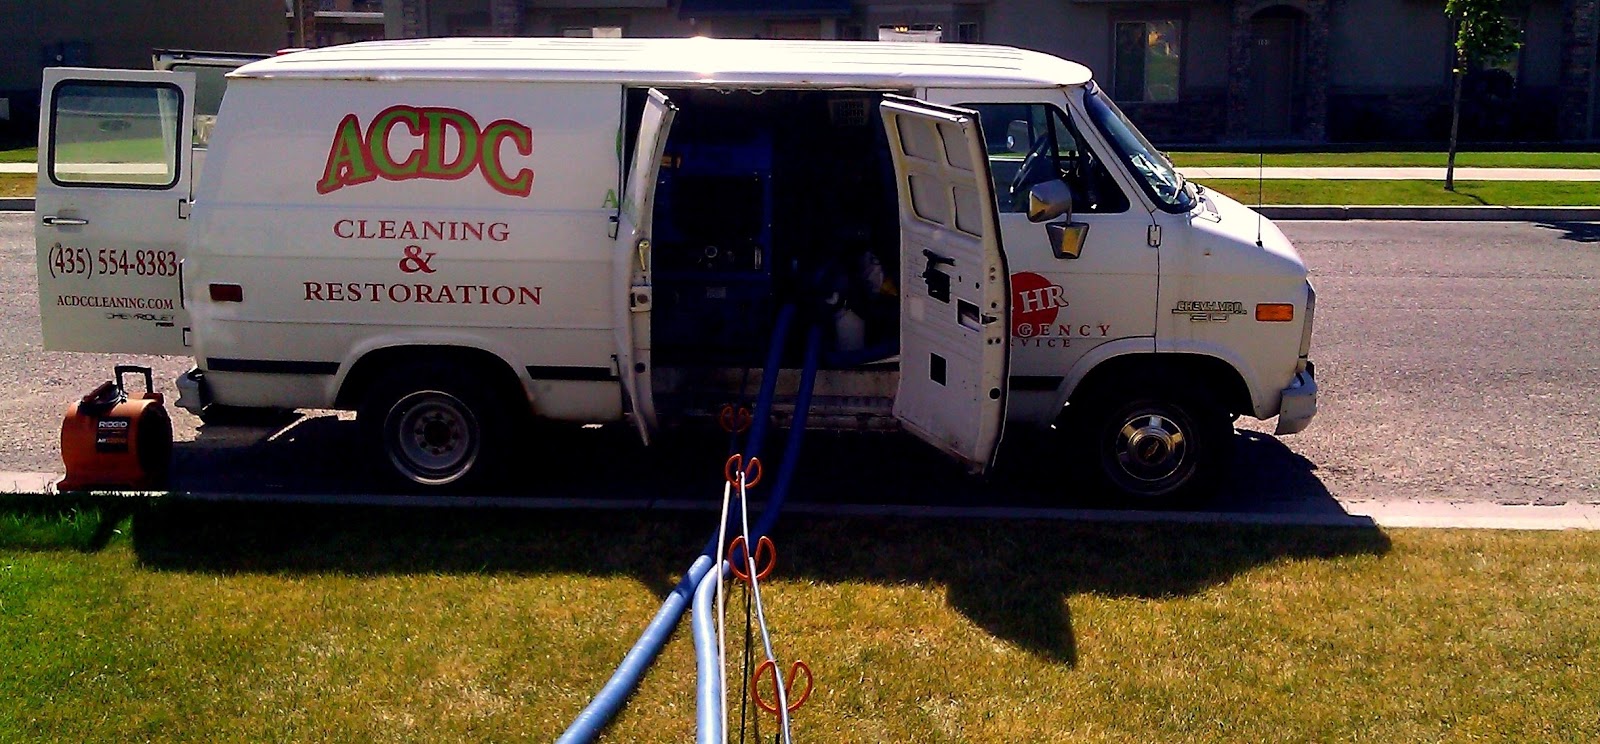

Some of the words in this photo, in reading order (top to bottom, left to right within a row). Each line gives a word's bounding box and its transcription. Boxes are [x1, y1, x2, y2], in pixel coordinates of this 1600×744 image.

[316, 104, 535, 198] ACDC
[333, 219, 510, 242] CLEANING
[48, 246, 93, 279] (435)
[98, 249, 178, 277] 554-8383
[399, 244, 437, 274] &
[57, 295, 174, 310] ACDCCLEANING.COM
[303, 281, 543, 306] RESTORATION
